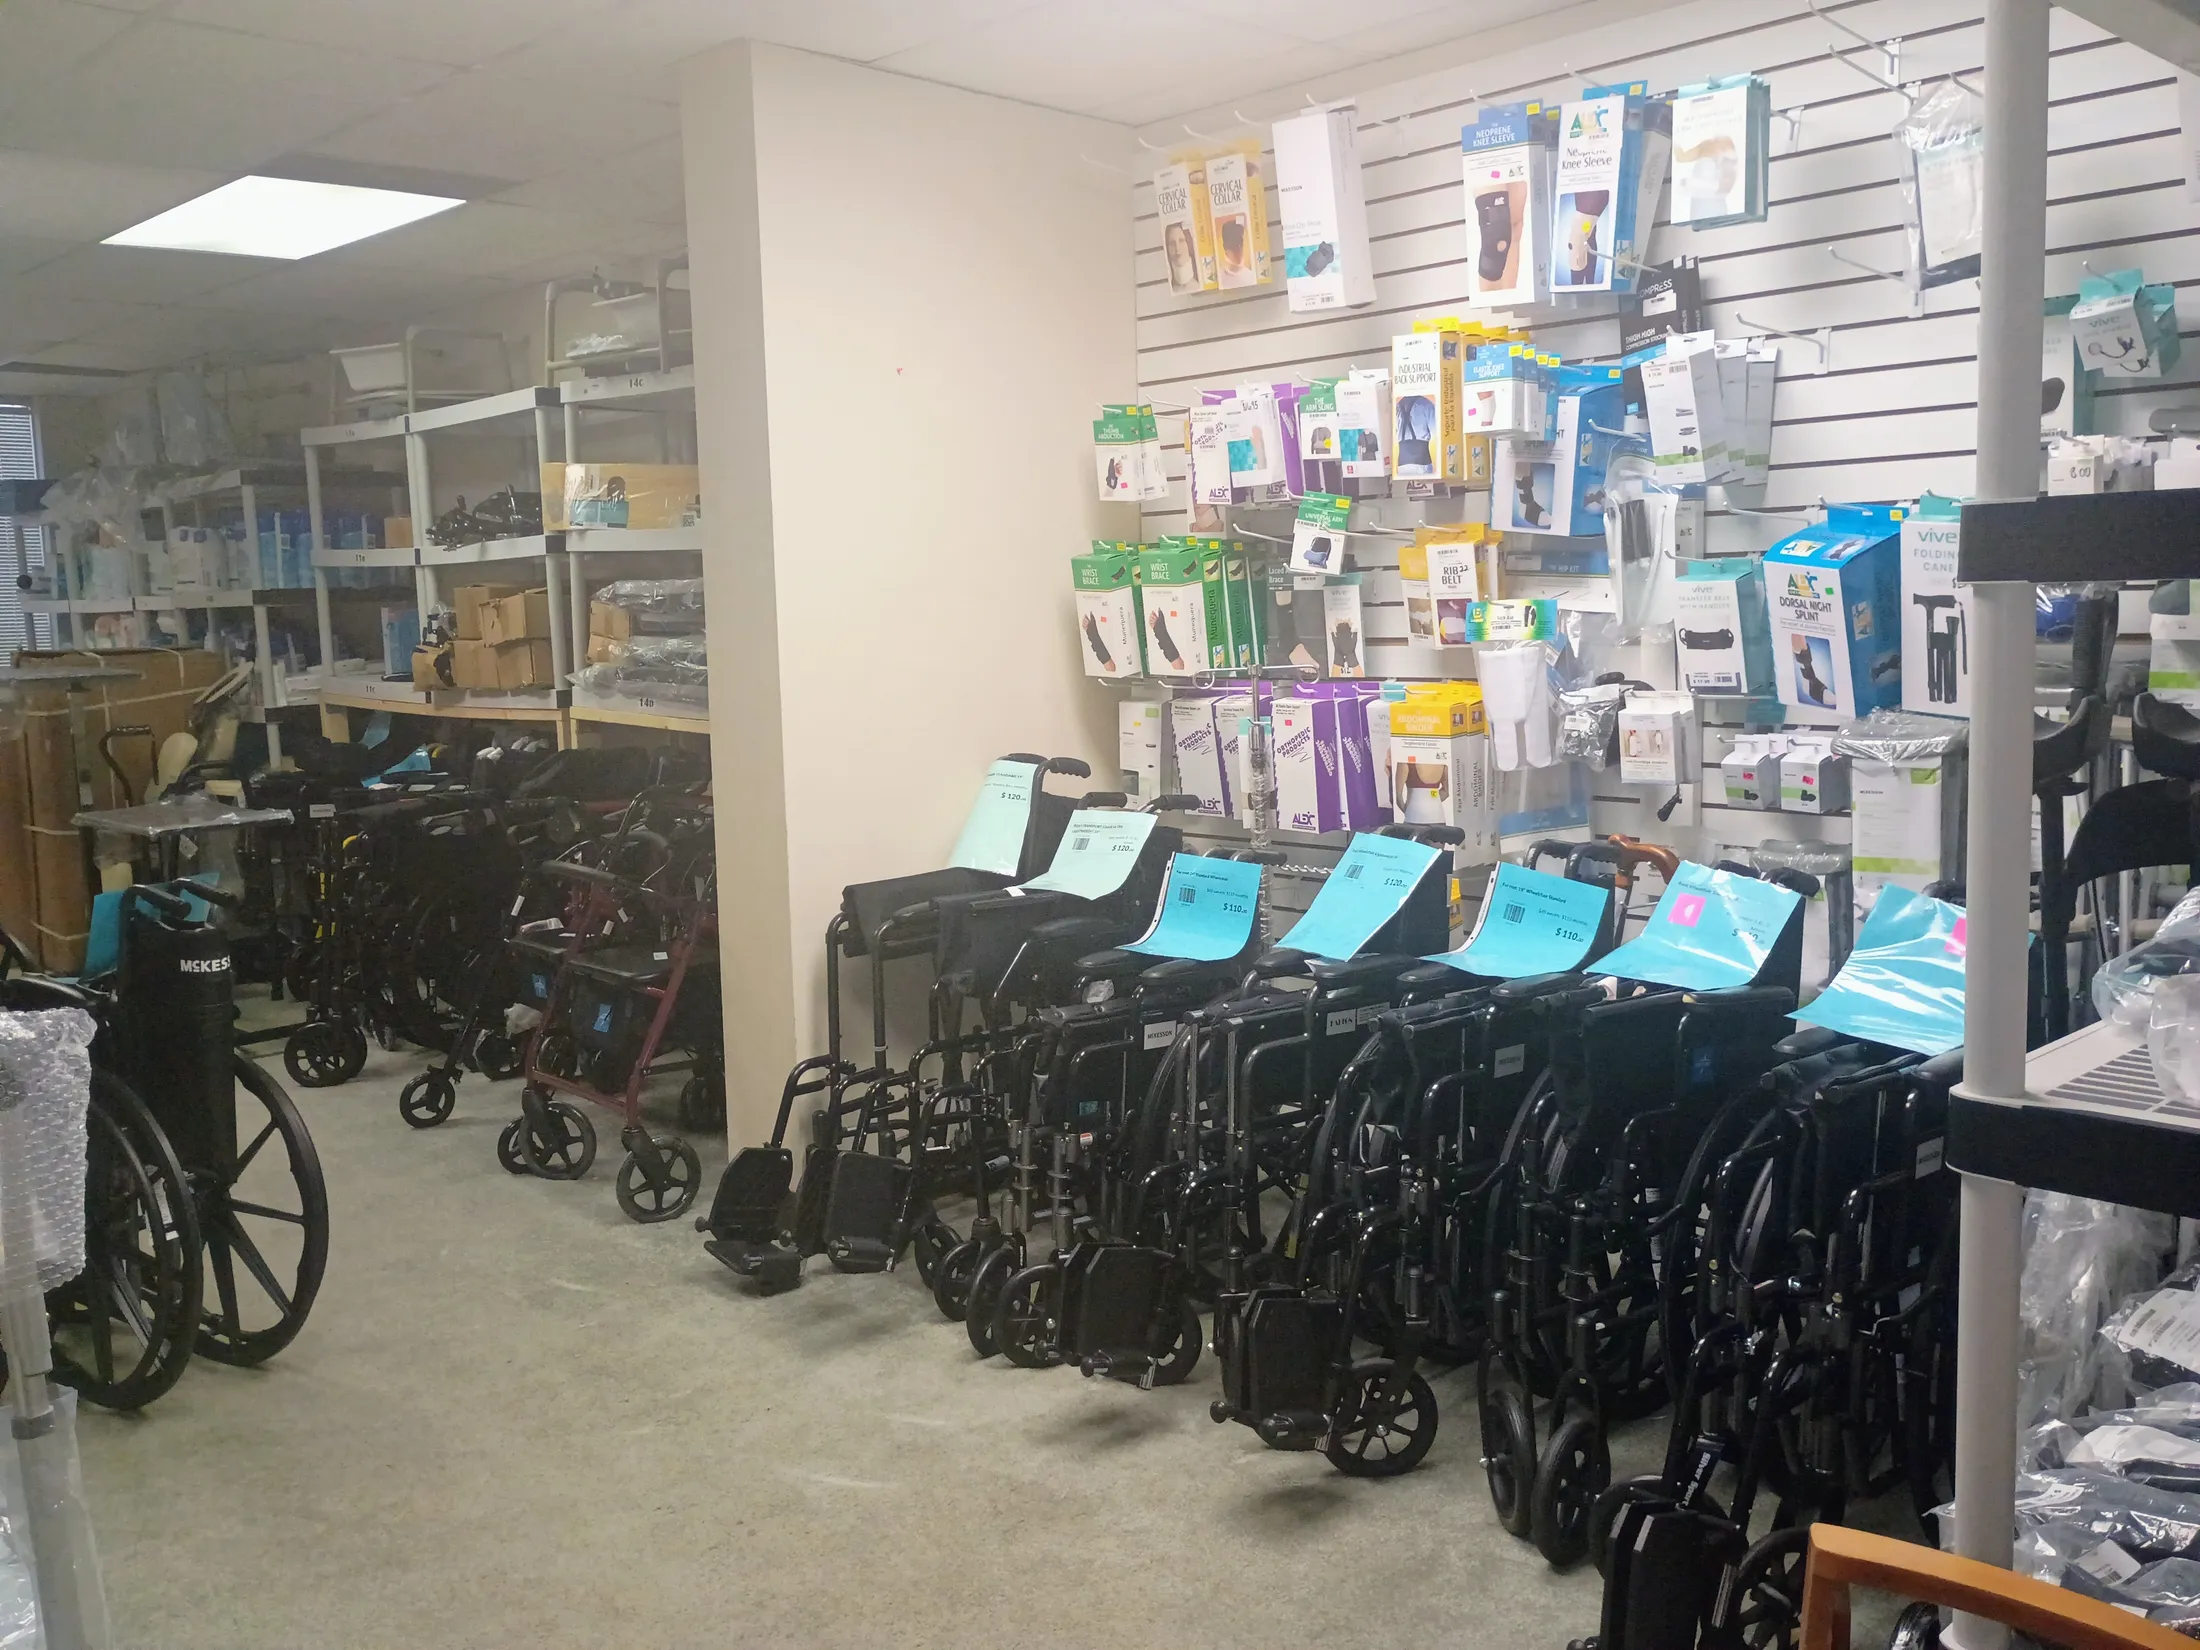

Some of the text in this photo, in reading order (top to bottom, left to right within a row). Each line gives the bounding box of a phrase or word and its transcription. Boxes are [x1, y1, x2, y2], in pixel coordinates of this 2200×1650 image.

[1476, 126, 1511, 138] NEOPRENE
[1473, 132, 1515, 147] KNEE SLEEVE
[1562, 156, 1612, 170] Knee Sleeve
[1209, 178, 1243, 196] CERVICAL
[1158, 187, 1187, 206] CERVICAL
[1213, 190, 1242, 206] COLLAR
[1162, 199, 1187, 215] COLLAR
[1398, 362, 1431, 374] INDUSTRIAL
[1395, 372, 1436, 384] BACK SUPPORT
[1306, 402, 1334, 412] ARM SLING
[1917, 528, 1958, 544] vive
[1913, 548, 1957, 560] FOLDIN
[1081, 568, 1098, 578] WRIST
[1151, 562, 1168, 572] WRIST
[1268, 567, 1285, 575] Laced
[1443, 565, 1459, 575] RIB
[1569, 564, 1580, 573] KIT
[1923, 562, 1954, 573] CANE
[1082, 576, 1100, 585] BRACE
[1151, 571, 1170, 580] BRACE
[1268, 575, 1284, 584] Brace
[1441, 574, 1462, 585] BELT
[1779, 596, 1832, 613] DORSAL NIGHT
[1795, 610, 1819, 622] SPLINT
[1184, 730, 1212, 751] PRODUCTS
[1277, 726, 1311, 754] ORTHOPEDIC
[1282, 735, 1310, 758] PRODUCTS
[1292, 811, 1316, 826] ALEX
[1223, 903, 1229, 911] $
[1555, 927, 1562, 937] $
